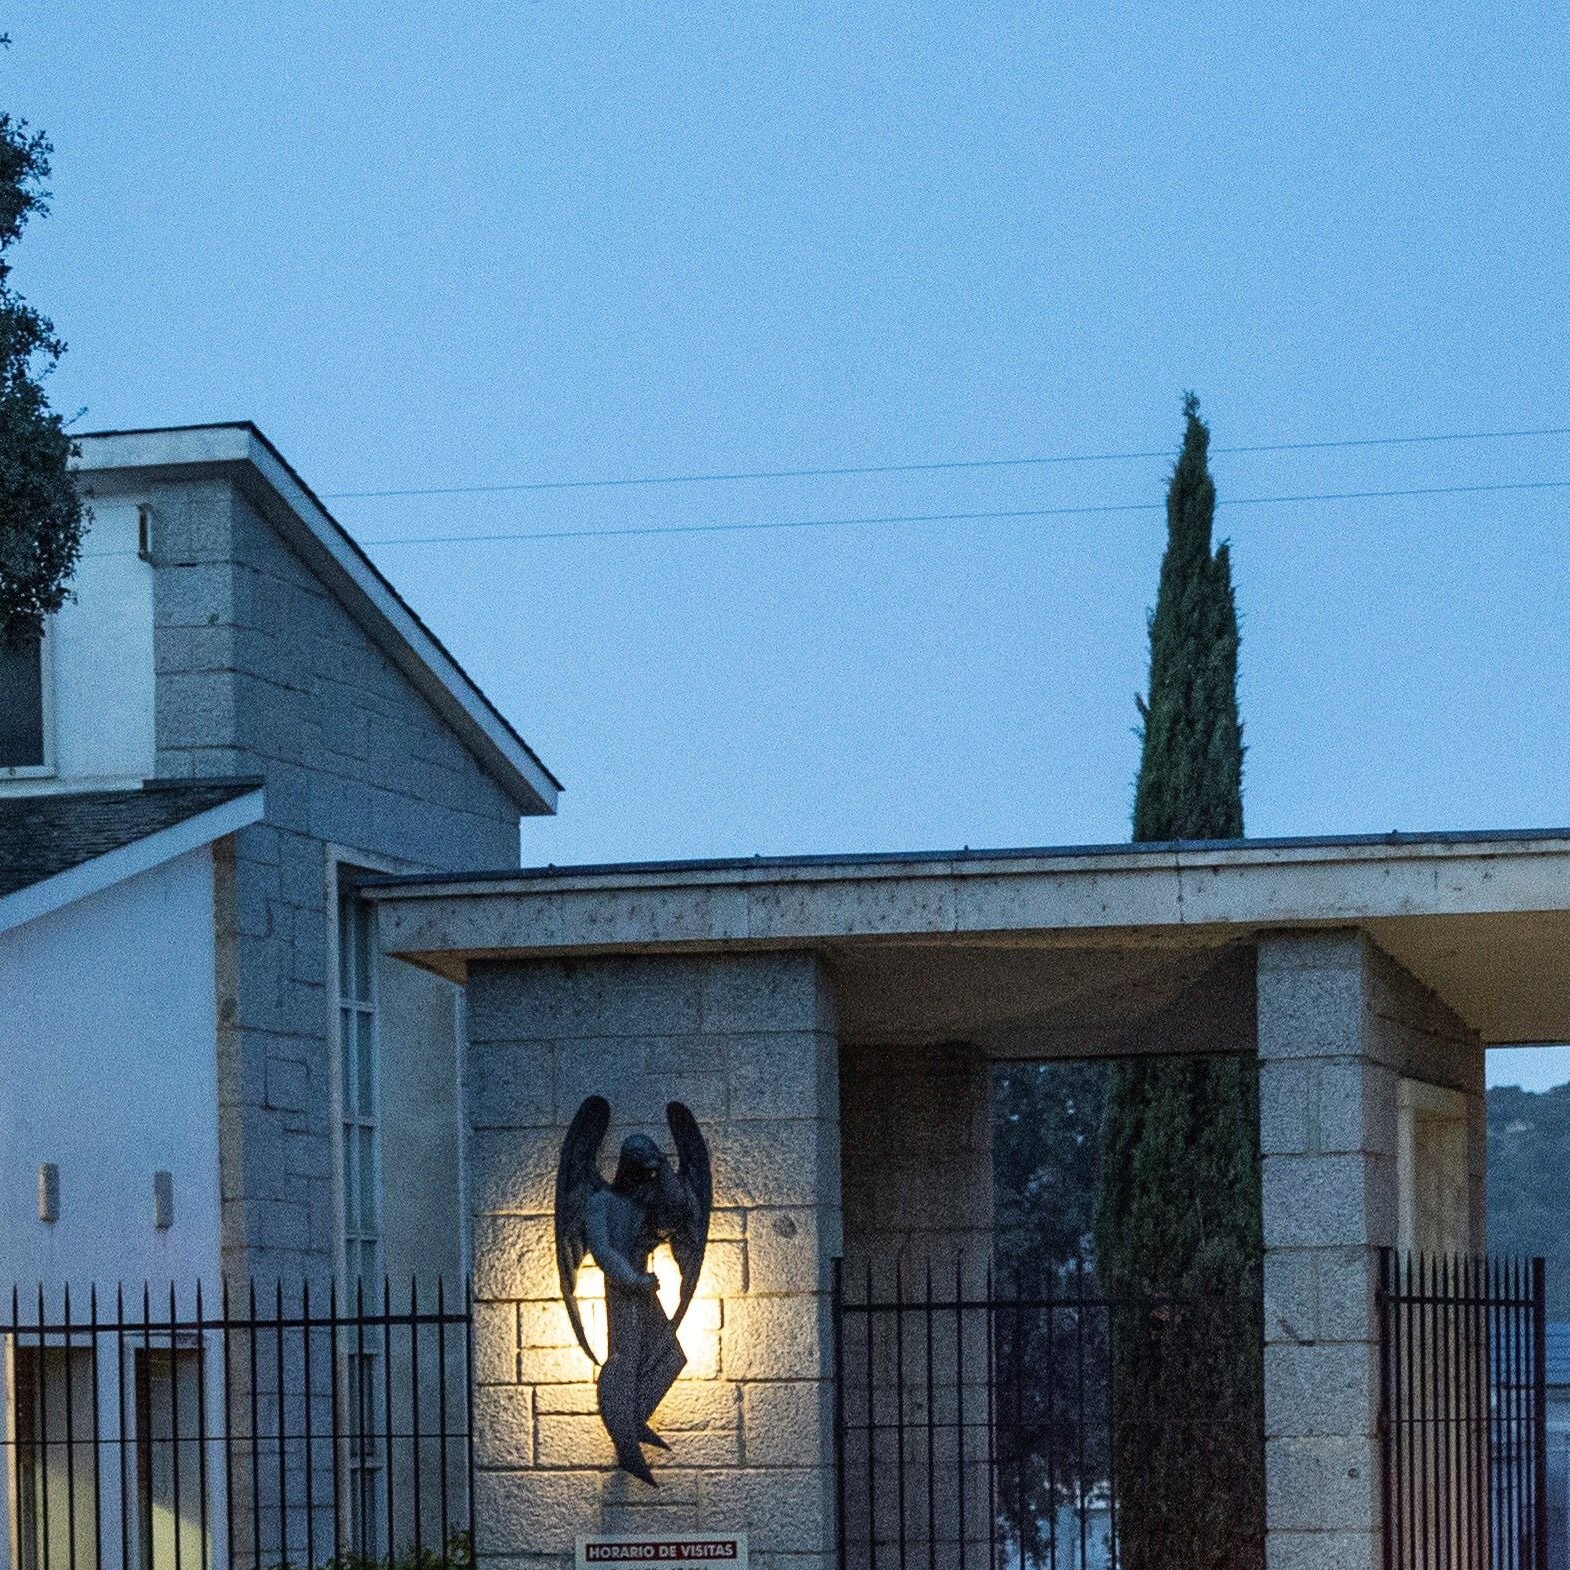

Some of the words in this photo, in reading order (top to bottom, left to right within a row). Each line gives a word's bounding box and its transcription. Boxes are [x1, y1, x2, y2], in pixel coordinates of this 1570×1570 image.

[588, 1545, 655, 1559] HORARIO
[659, 1545, 678, 1558] DE
[681, 1544, 734, 1556] VISITAS
